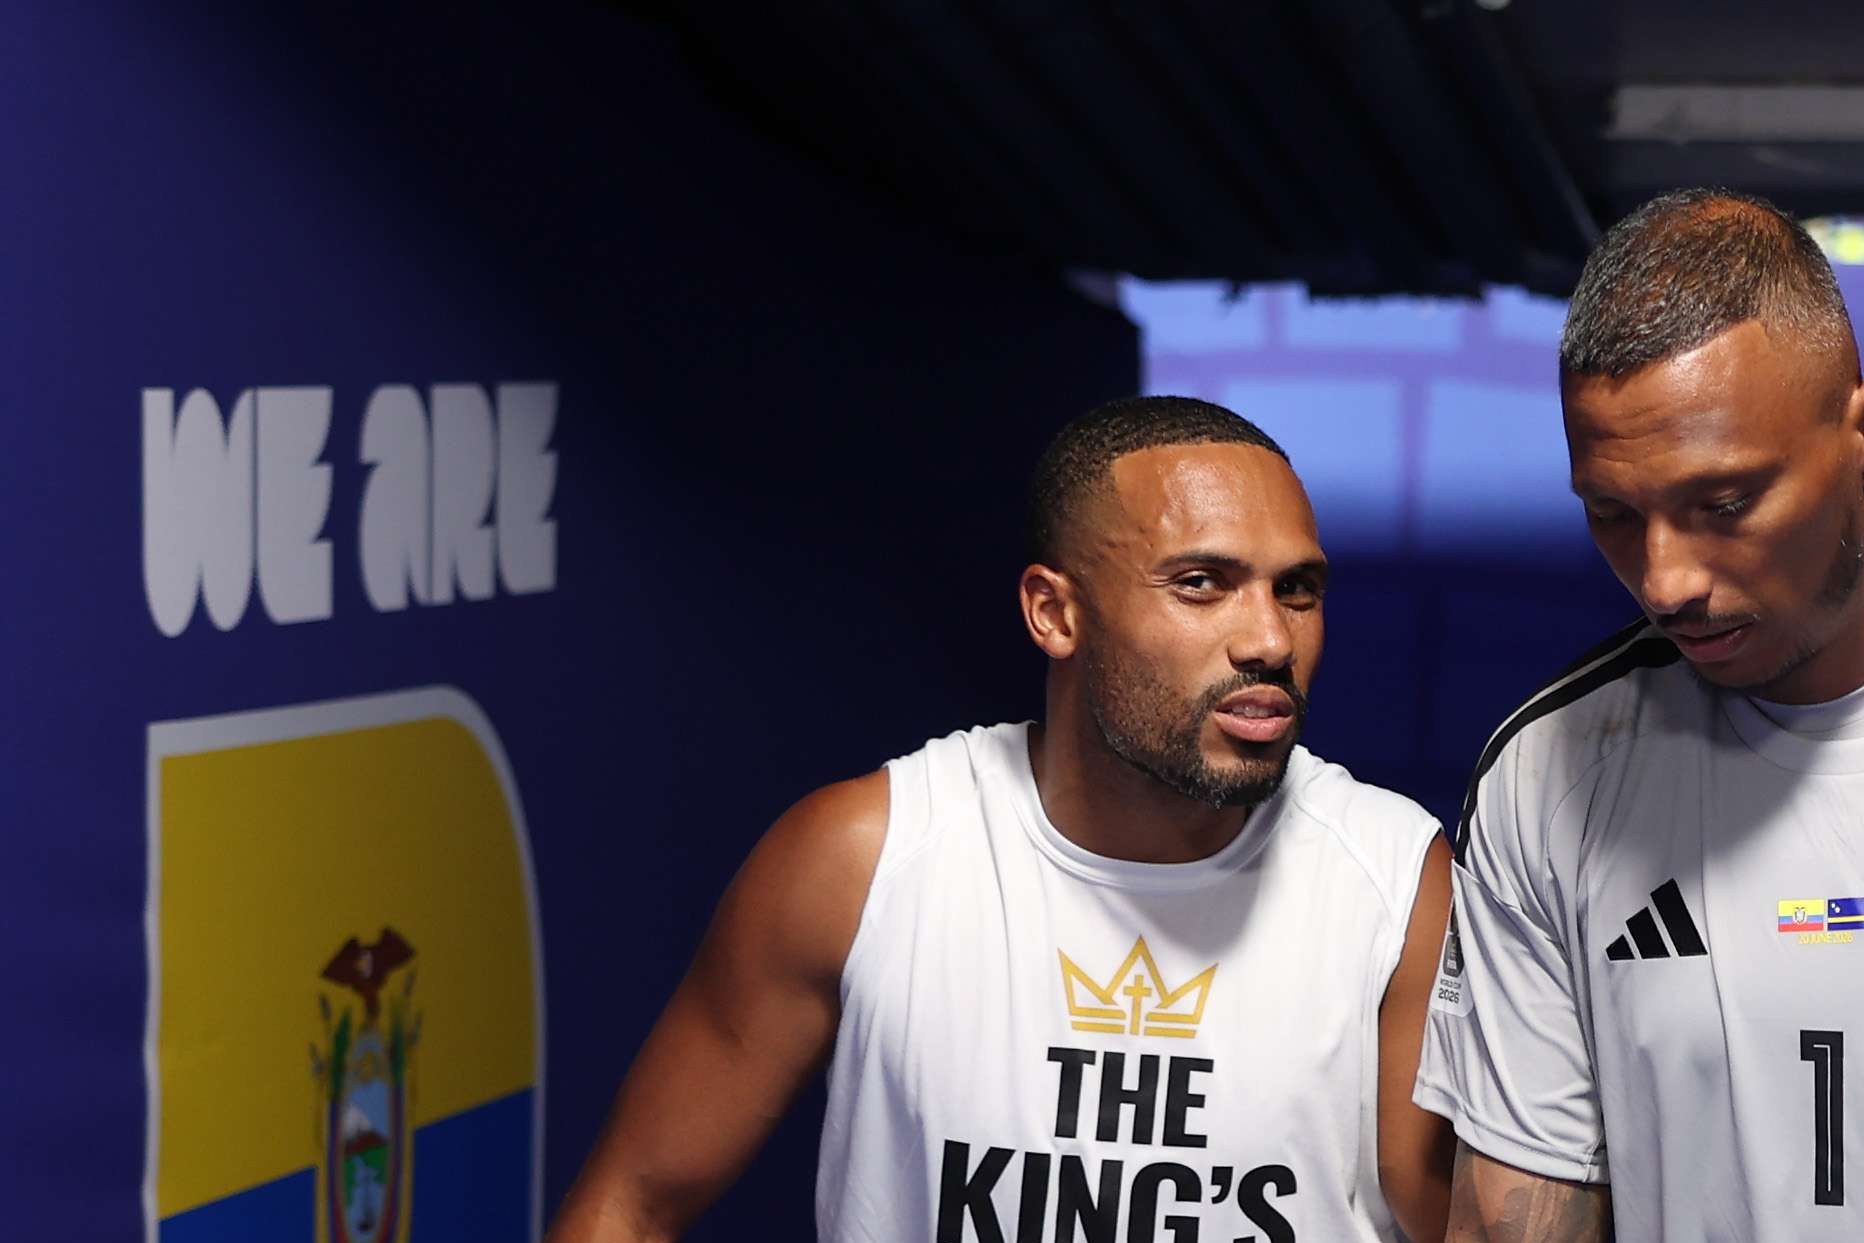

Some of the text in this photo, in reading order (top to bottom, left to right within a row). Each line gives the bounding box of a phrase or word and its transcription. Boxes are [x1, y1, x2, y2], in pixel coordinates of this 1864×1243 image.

[141, 381, 558, 637] WE ARE
[1438, 987, 1460, 1004] 2026
[1046, 1046, 1214, 1149] THE
[1800, 1029, 1844, 1206] 1
